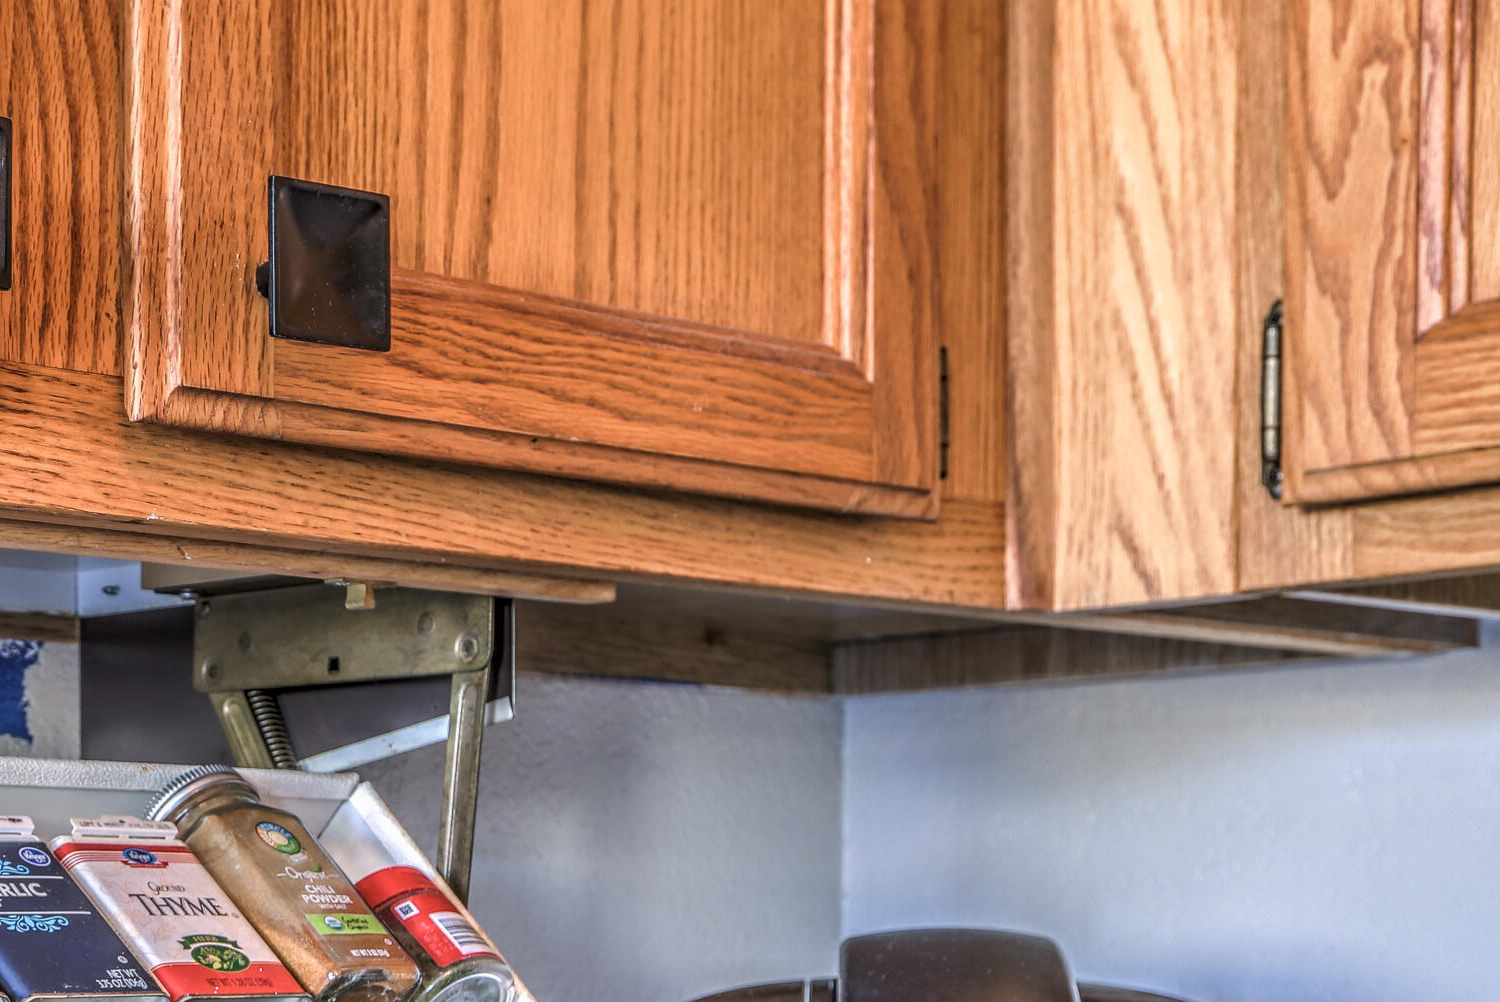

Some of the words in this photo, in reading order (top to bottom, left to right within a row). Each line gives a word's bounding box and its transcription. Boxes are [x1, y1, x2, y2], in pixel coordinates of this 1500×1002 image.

[305, 884, 335, 894] CHILI
[301, 894, 353, 904] POWDER
[128, 893, 228, 917] THYME
[106, 969, 122, 978] NET
[122, 969, 139, 978] WT
